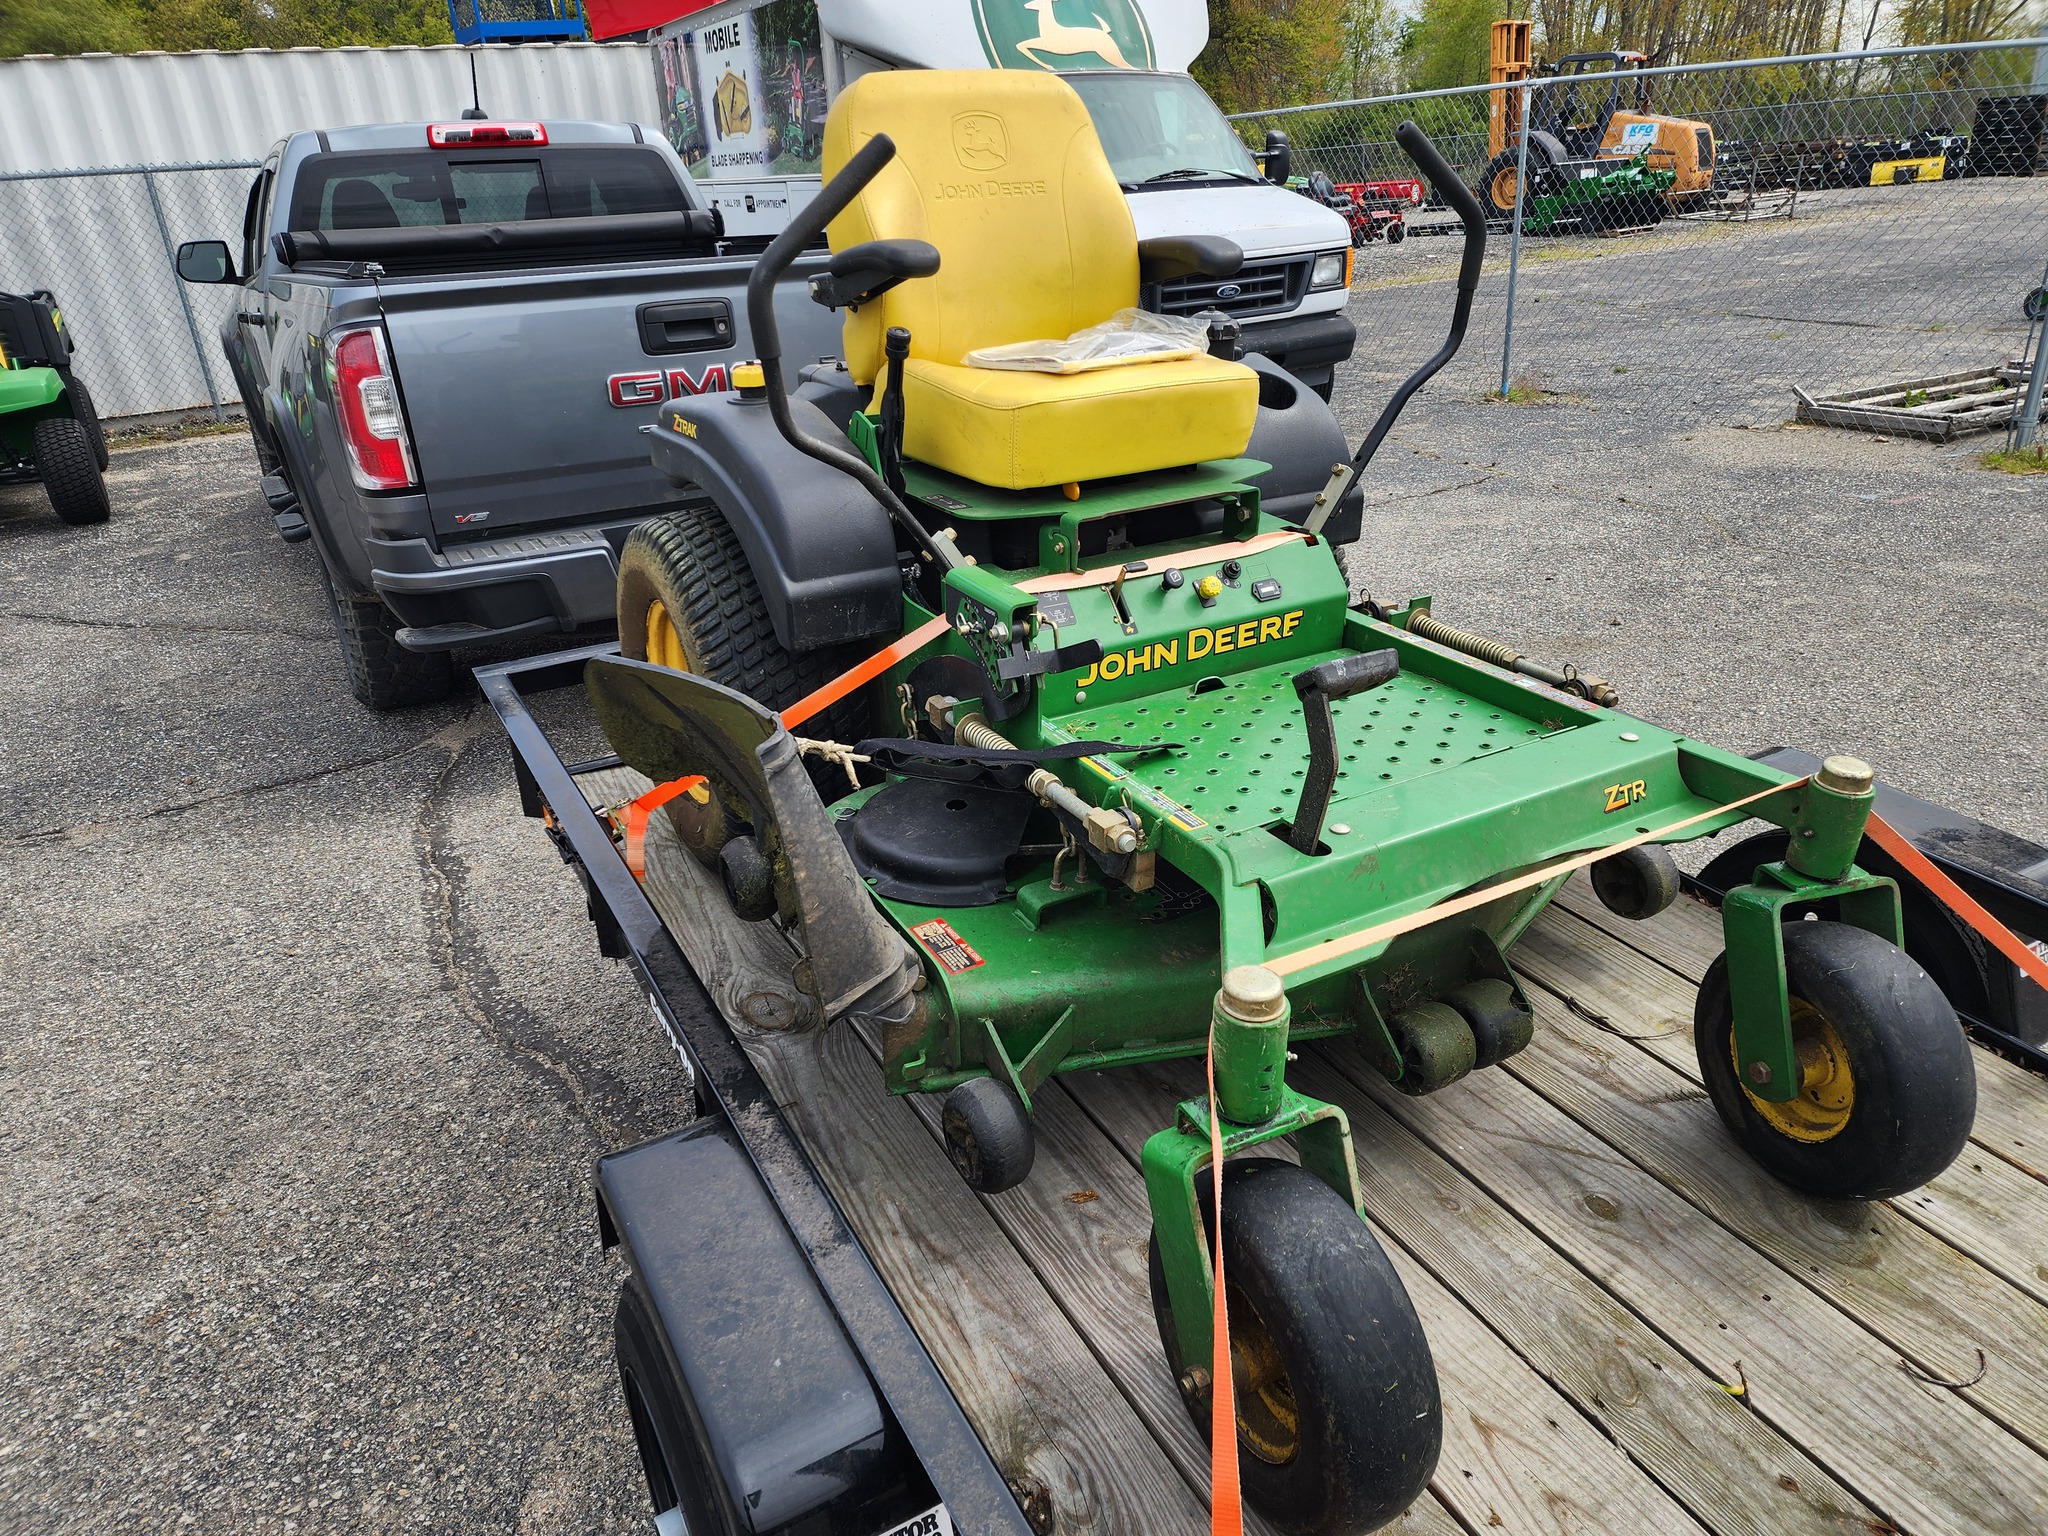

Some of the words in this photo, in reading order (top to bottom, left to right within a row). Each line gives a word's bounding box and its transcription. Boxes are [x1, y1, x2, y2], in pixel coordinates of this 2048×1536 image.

[704, 22, 741, 54] MOBILE
[711, 153, 728, 168] BLADE
[728, 151, 764, 167] SHARPENING
[724, 200, 733, 208] CALL
[733, 199, 741, 208] FOR
[756, 199, 785, 209] APPOINTMENT
[935, 183, 983, 201] JOHN
[985, 181, 1047, 197] DEERE
[672, 413, 698, 440] ZTRAK
[1076, 637, 1179, 688] JOHN
[1603, 779, 1647, 814] ZTR
